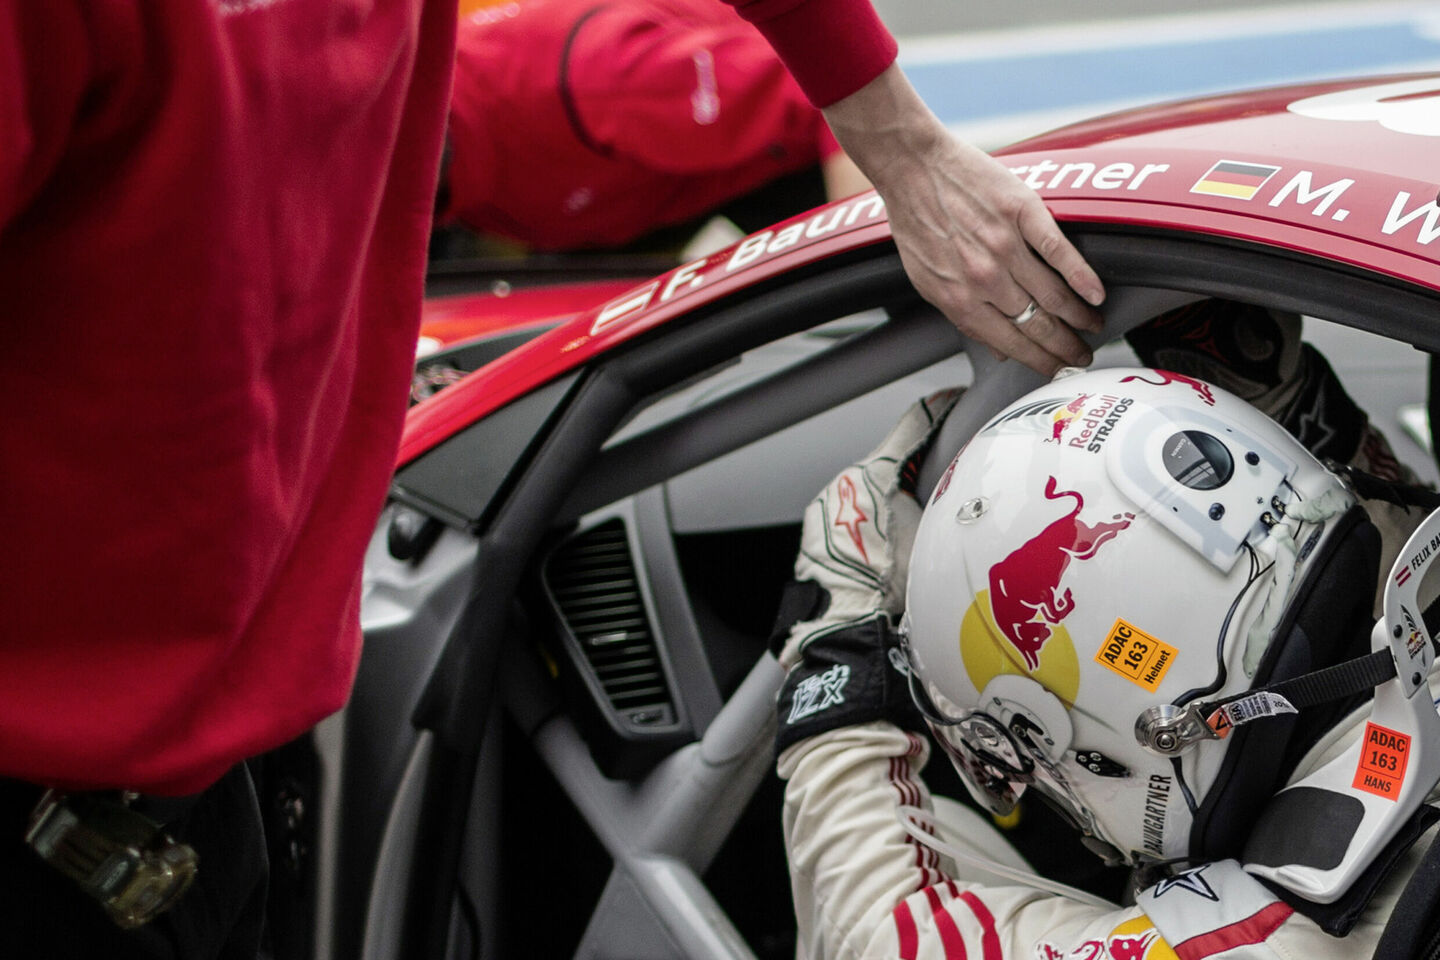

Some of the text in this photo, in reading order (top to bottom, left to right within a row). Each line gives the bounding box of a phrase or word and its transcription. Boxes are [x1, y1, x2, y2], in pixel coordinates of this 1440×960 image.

[1268, 170, 1355, 222] M.
[661, 261, 704, 304] F.
[1068, 394, 1119, 449] Red Bull
[1087, 397, 1134, 454] STRATOS
[1411, 545, 1431, 570] FELIX
[1104, 626, 1132, 664] ADAC
[1124, 641, 1148, 670] 163
[797, 664, 851, 691] Tech
[1144, 650, 1171, 684] Helmet
[1369, 730, 1406, 752] ADAC
[1369, 751, 1397, 771] 163
[1364, 775, 1392, 792] HANS
[1143, 774, 1172, 856] BAUMGARTNER
